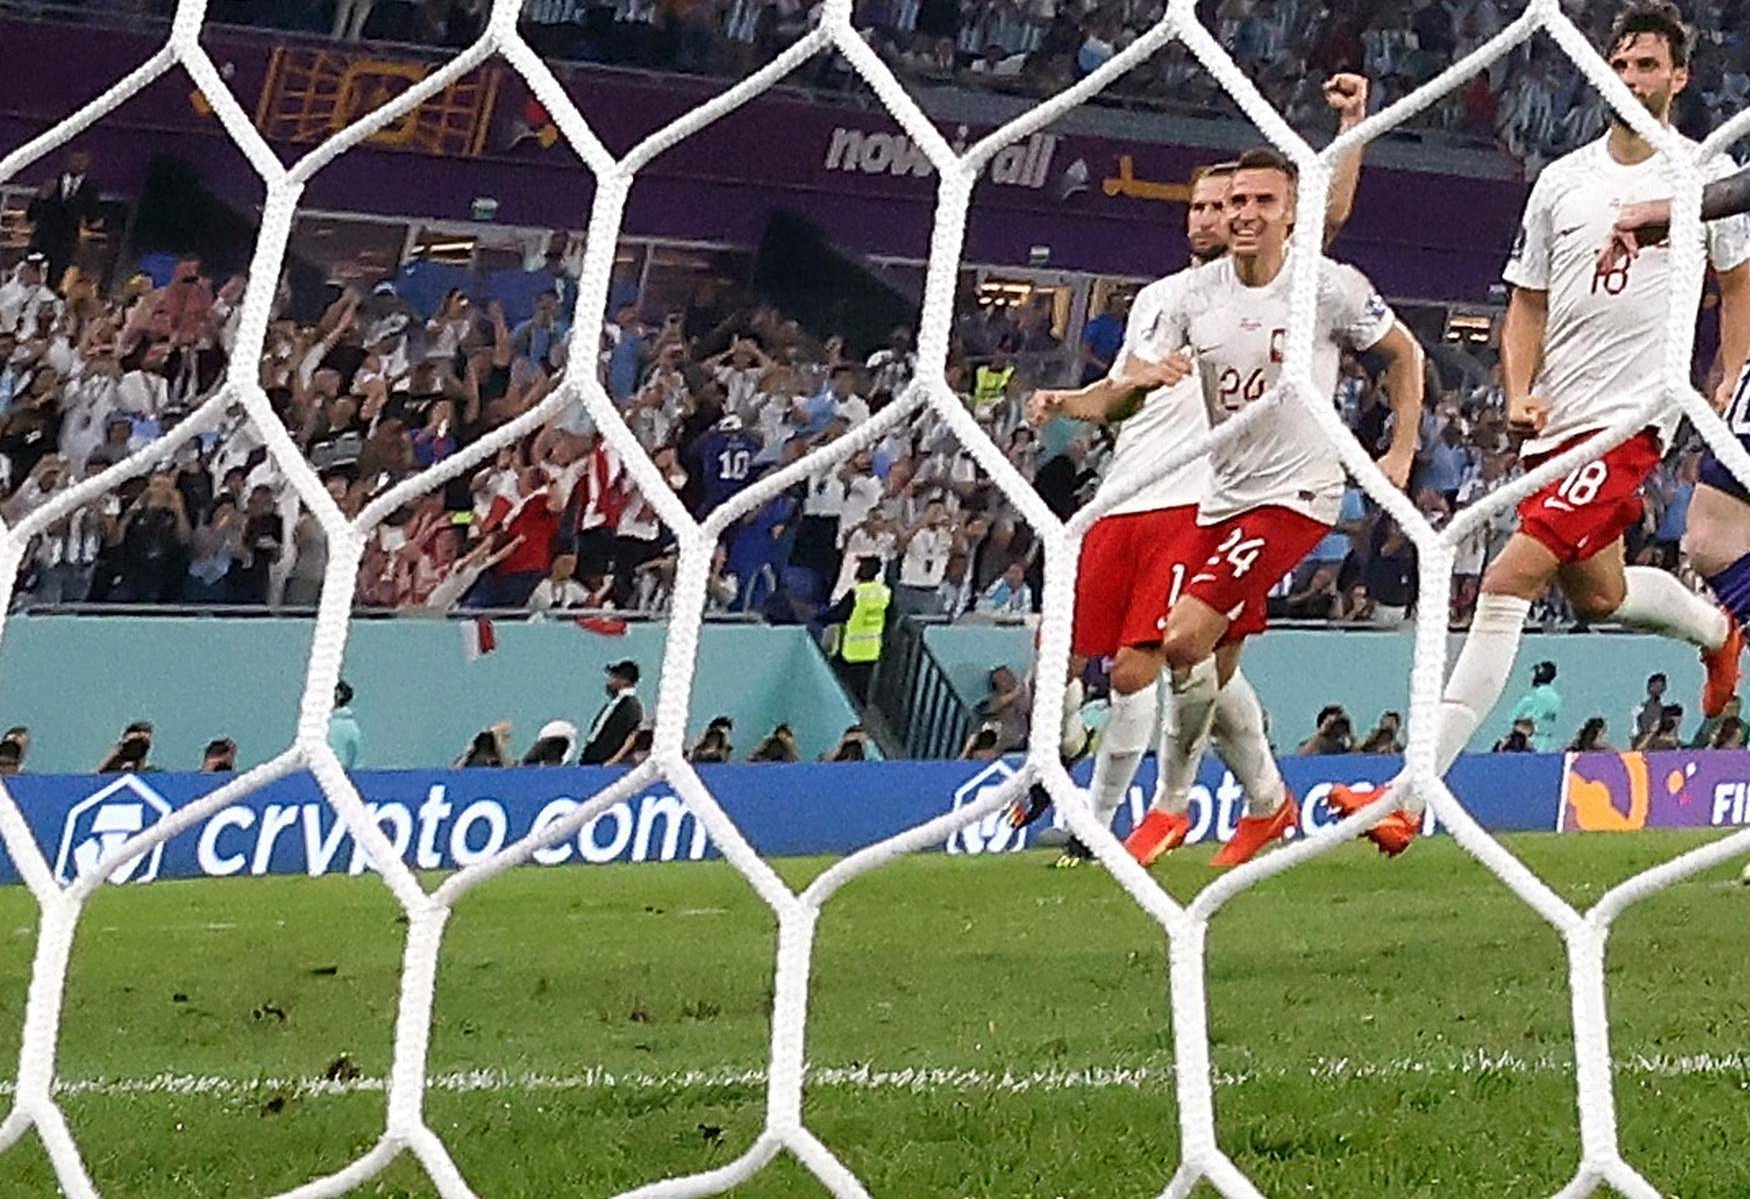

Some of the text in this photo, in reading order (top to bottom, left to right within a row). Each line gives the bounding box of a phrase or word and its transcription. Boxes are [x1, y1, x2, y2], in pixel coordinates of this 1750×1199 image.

[992, 131, 1056, 188] all
[718, 449, 751, 480] 10
[1558, 460, 1607, 505] 18
[1167, 563, 1186, 608] 1
